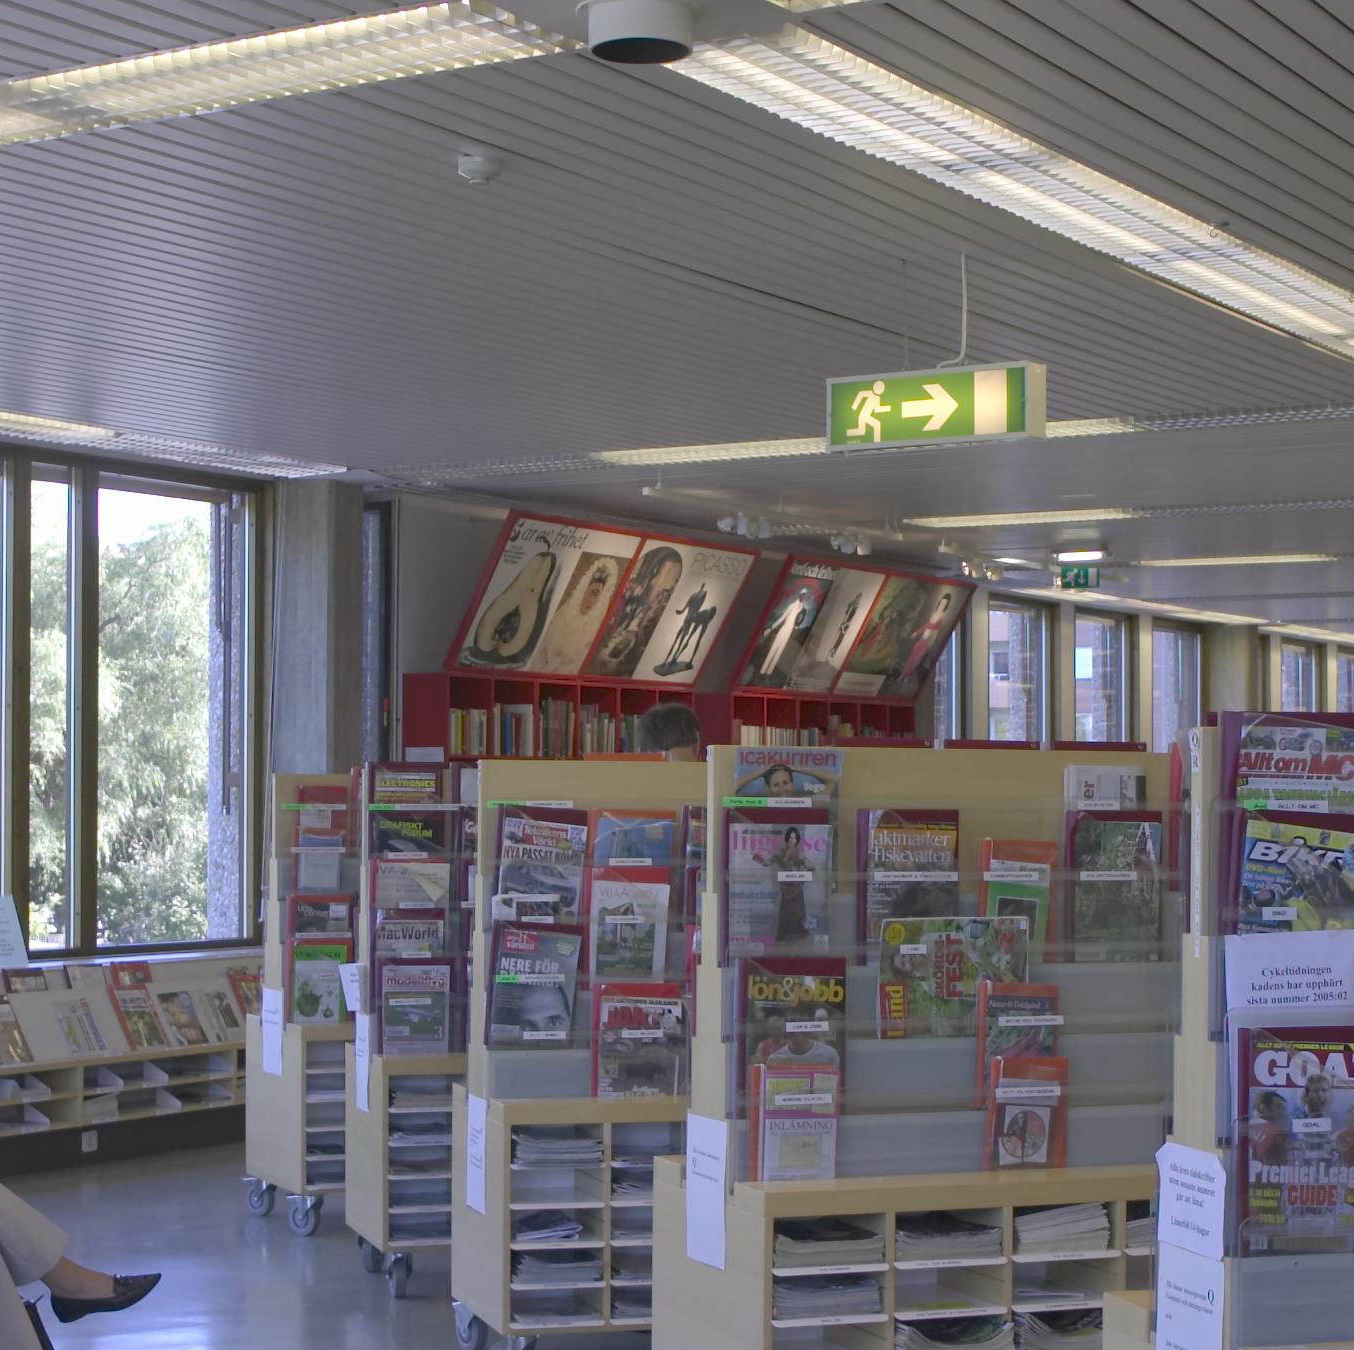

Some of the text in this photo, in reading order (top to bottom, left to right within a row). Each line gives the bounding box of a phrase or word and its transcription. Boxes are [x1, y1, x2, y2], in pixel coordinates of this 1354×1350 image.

[500, 956, 559, 974] NERE FÖR
[1261, 966, 1333, 979] Cykeltidningen
[1251, 979, 1343, 993] kadens har upphört
[1246, 991, 1348, 1006] sista nummer 2005:02
[1249, 1160, 1317, 1184] Premier
[1286, 1184, 1338, 1207] GUIDE
[1207, 1288, 1215, 1307] Q
